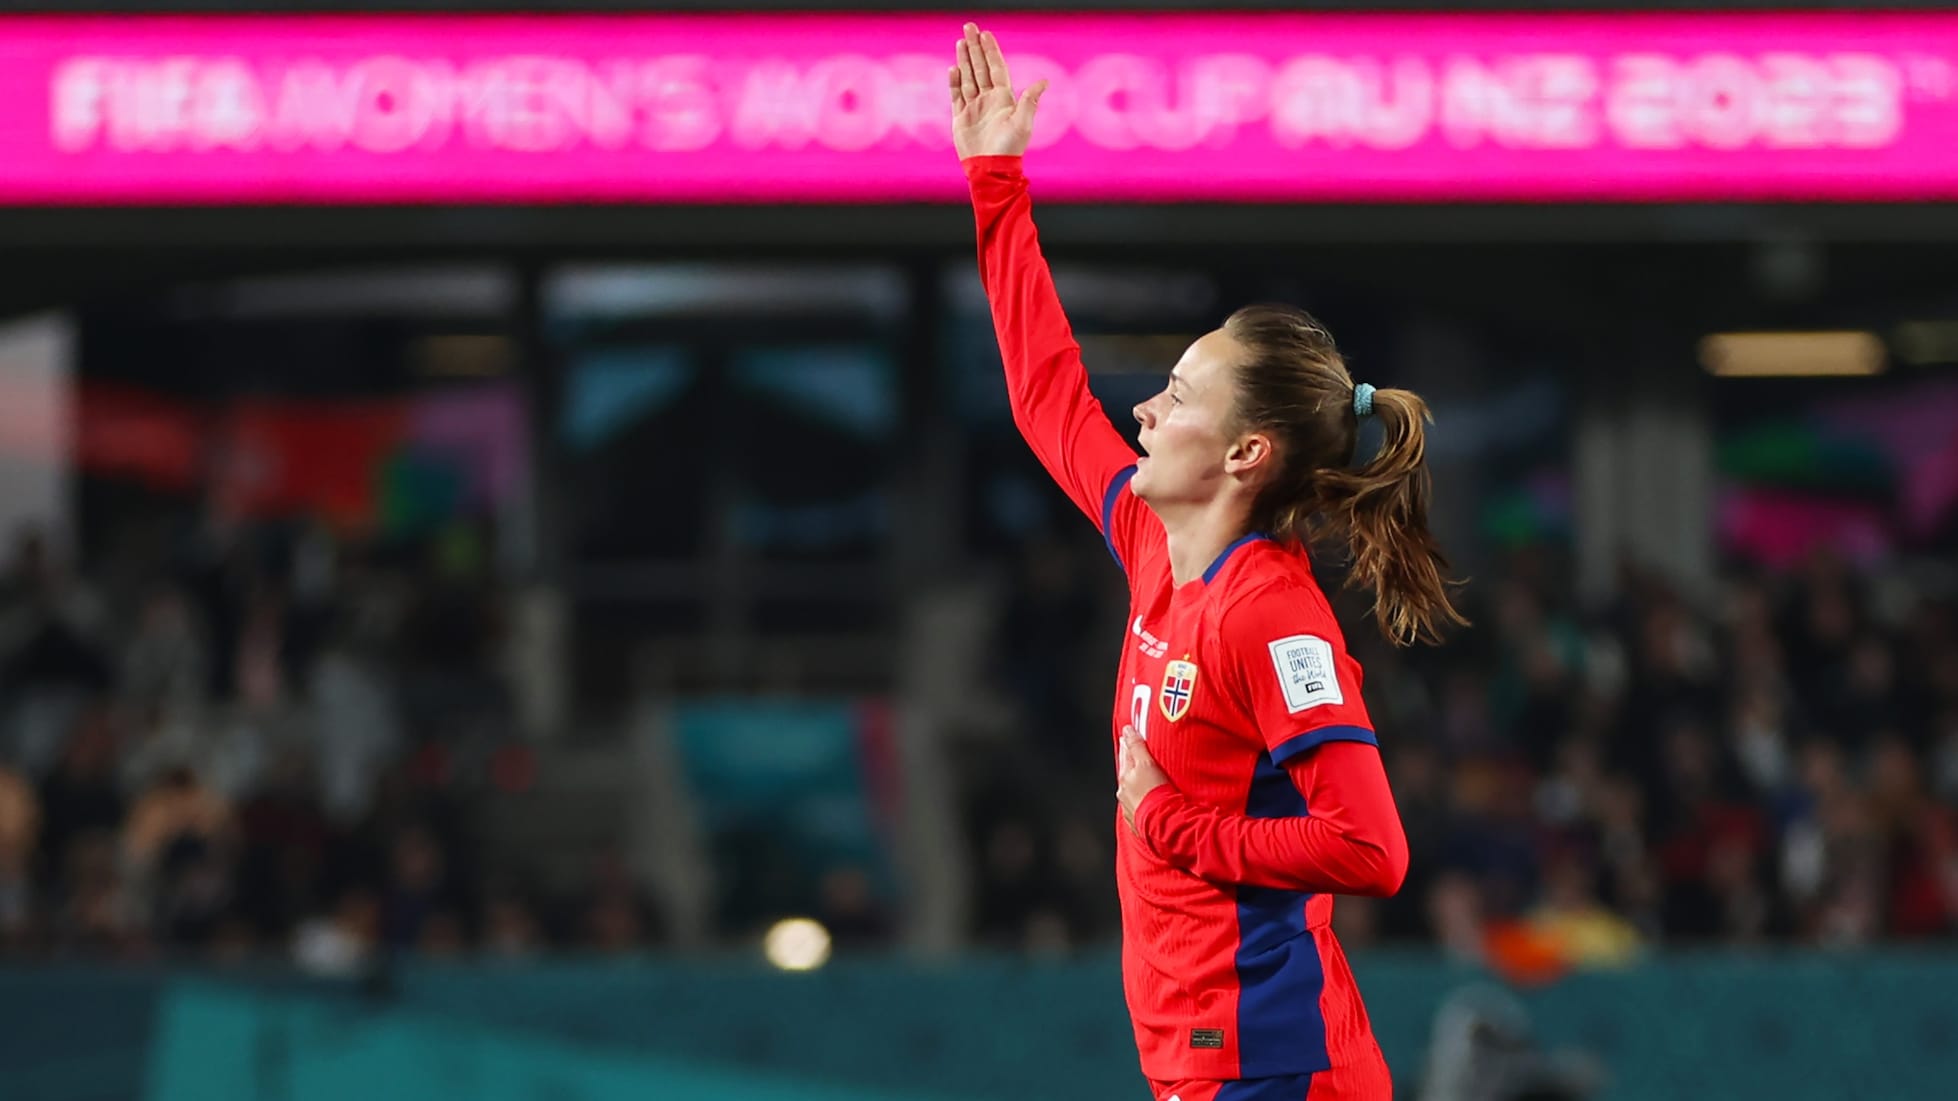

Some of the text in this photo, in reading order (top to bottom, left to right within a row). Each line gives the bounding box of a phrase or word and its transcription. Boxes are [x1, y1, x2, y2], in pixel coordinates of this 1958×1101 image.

[50, 54, 264, 153] FIFA
[730, 54, 1073, 152] WORD
[1074, 53, 1270, 152] CUP
[1605, 52, 1904, 150] 2023
[1286, 647, 1319, 660] FOOTBALL
[1290, 656, 1322, 673] UNITES
